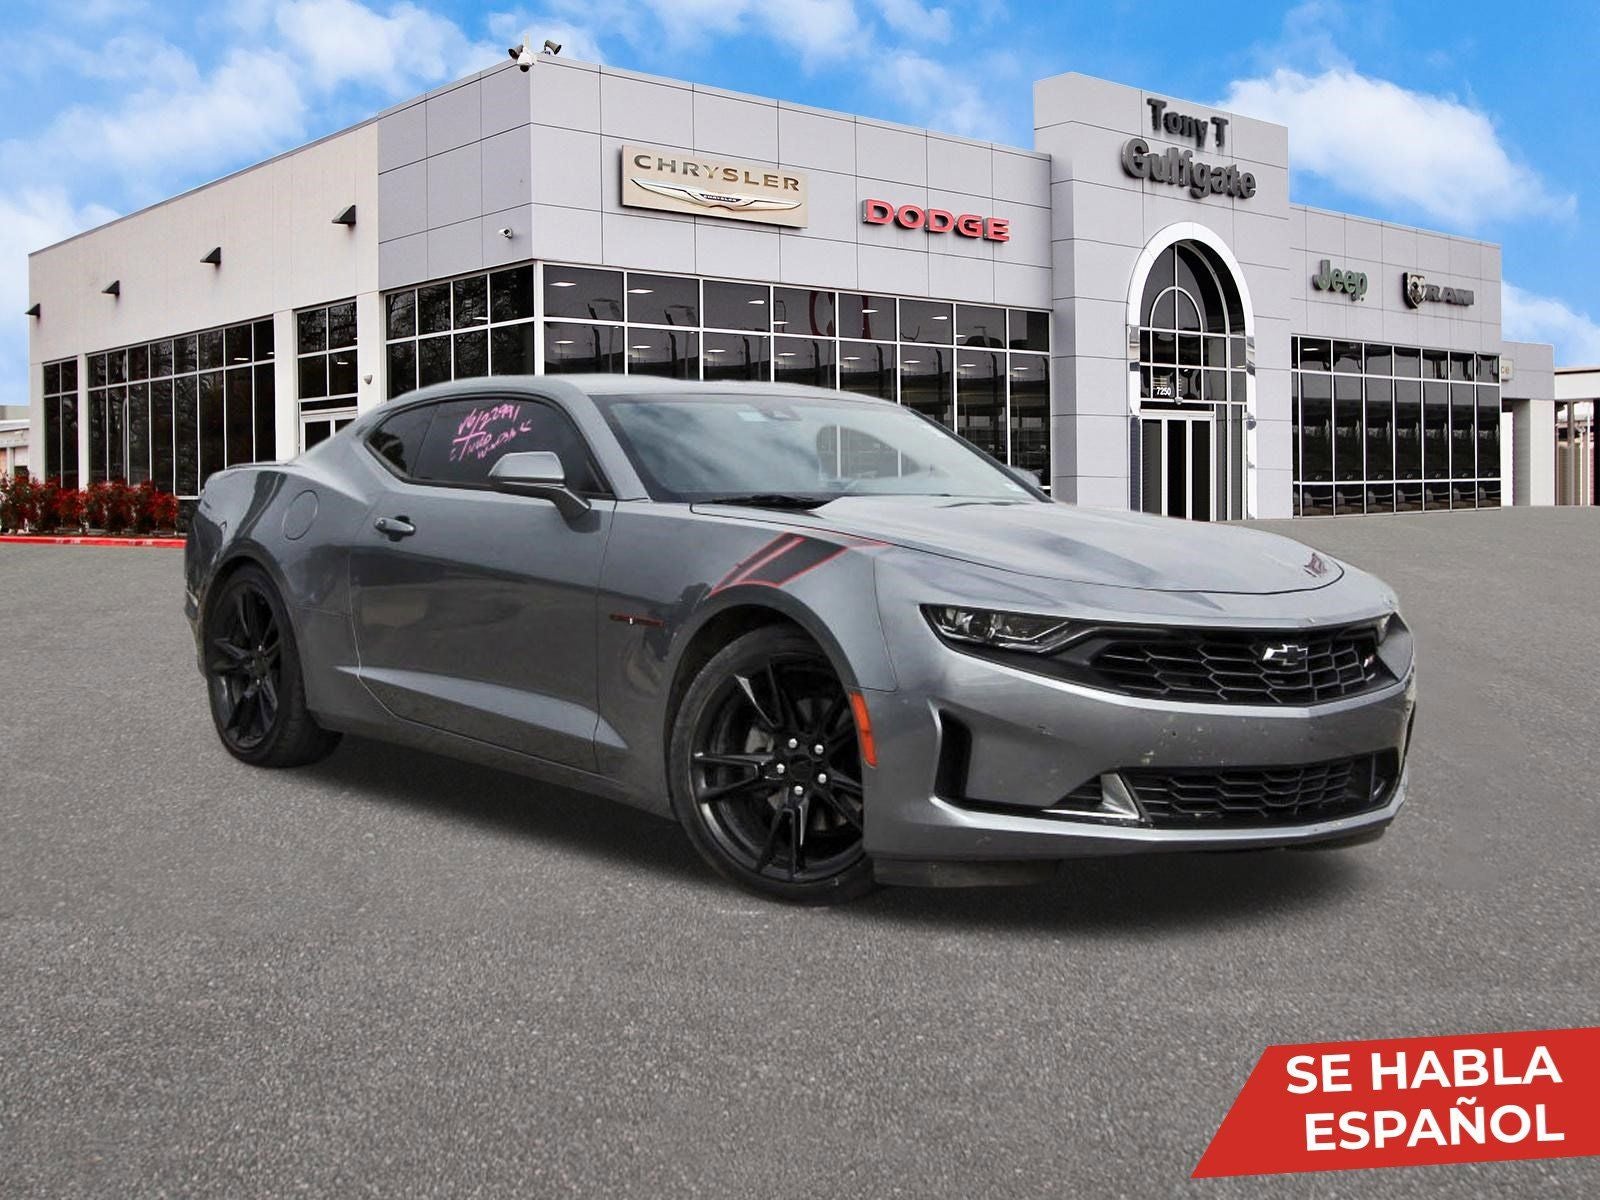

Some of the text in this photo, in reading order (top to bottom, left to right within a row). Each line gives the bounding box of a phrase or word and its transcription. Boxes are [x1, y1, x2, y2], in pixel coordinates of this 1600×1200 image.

[1147, 98, 1229, 147] Tony T
[634, 154, 800, 192] CHRYSLER
[1121, 138, 1257, 199] Gulfgate
[863, 199, 1010, 242] DODGE
[1312, 259, 1368, 302] Jeep
[1424, 283, 1475, 307] RAM
[1156, 386, 1172, 396] 7250
